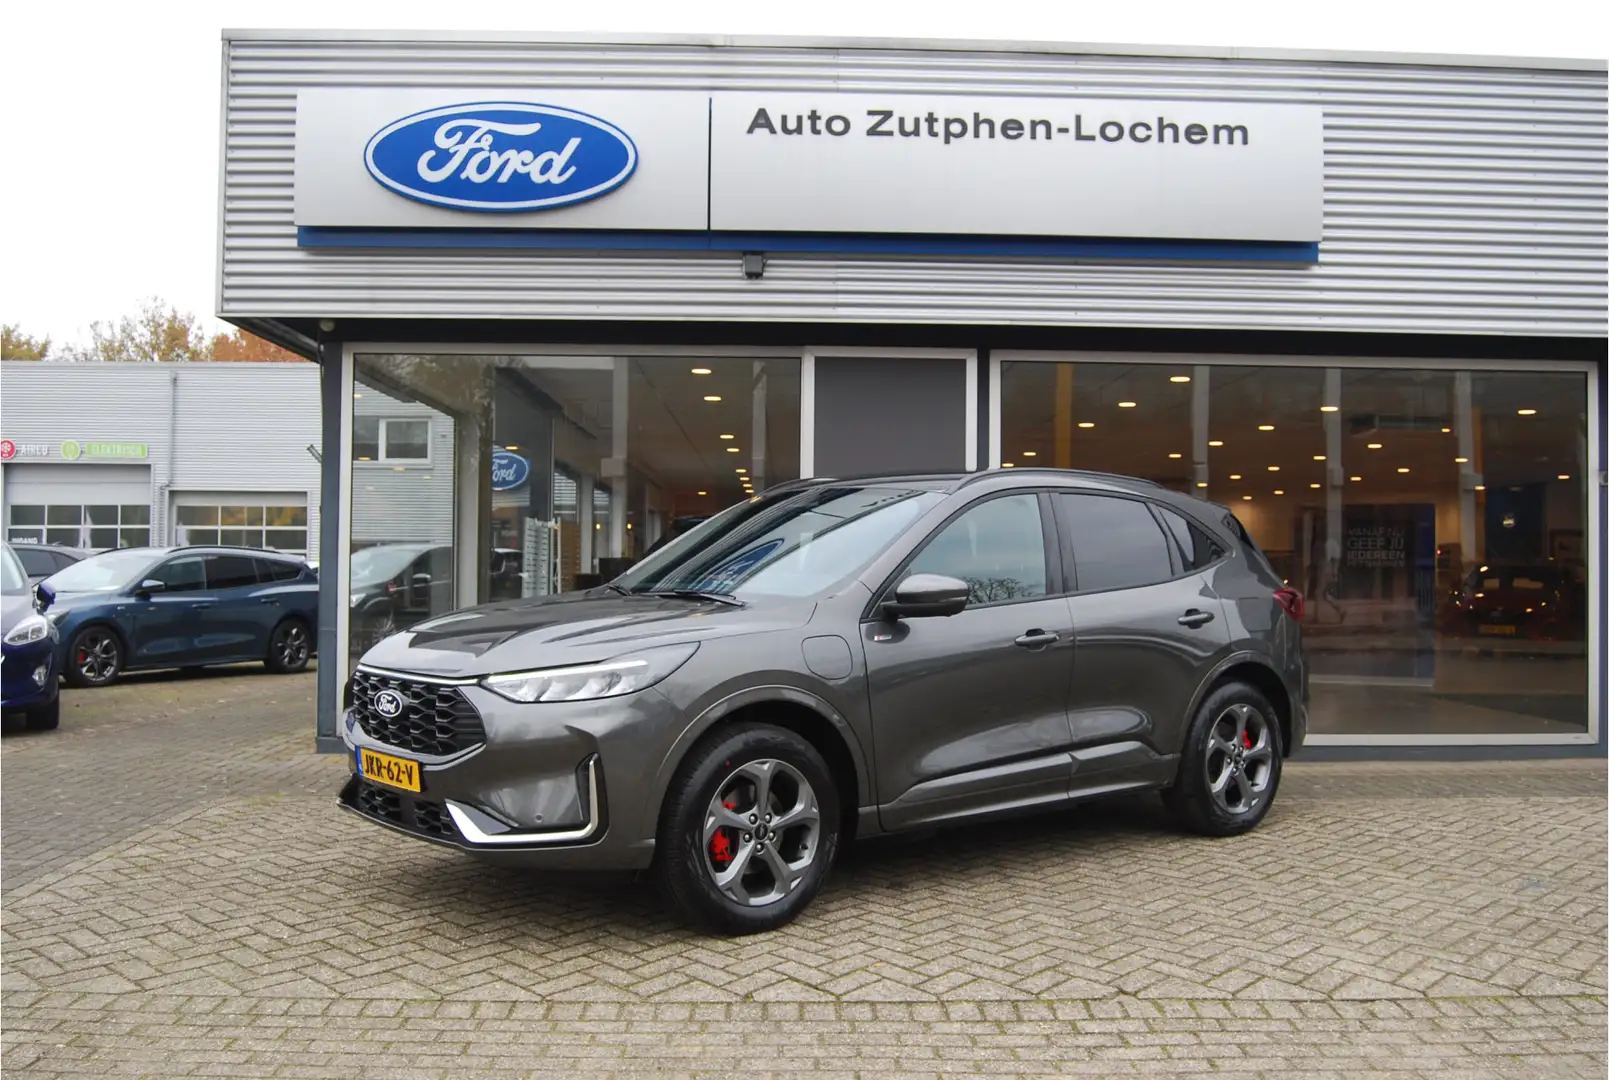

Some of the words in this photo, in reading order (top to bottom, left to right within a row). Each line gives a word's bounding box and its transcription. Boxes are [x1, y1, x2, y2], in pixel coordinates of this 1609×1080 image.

[747, 107, 851, 136] Auto
[866, 109, 1249, 146] Zutphen-Lochem
[417, 118, 582, 184] Ford
[20, 444, 49, 456] AIRCO
[1347, 537, 1386, 549] GEEF
[1347, 550, 1405, 560] IEDEREEN
[378, 694, 397, 713] Ford
[365, 754, 413, 786] JKR-62-V
